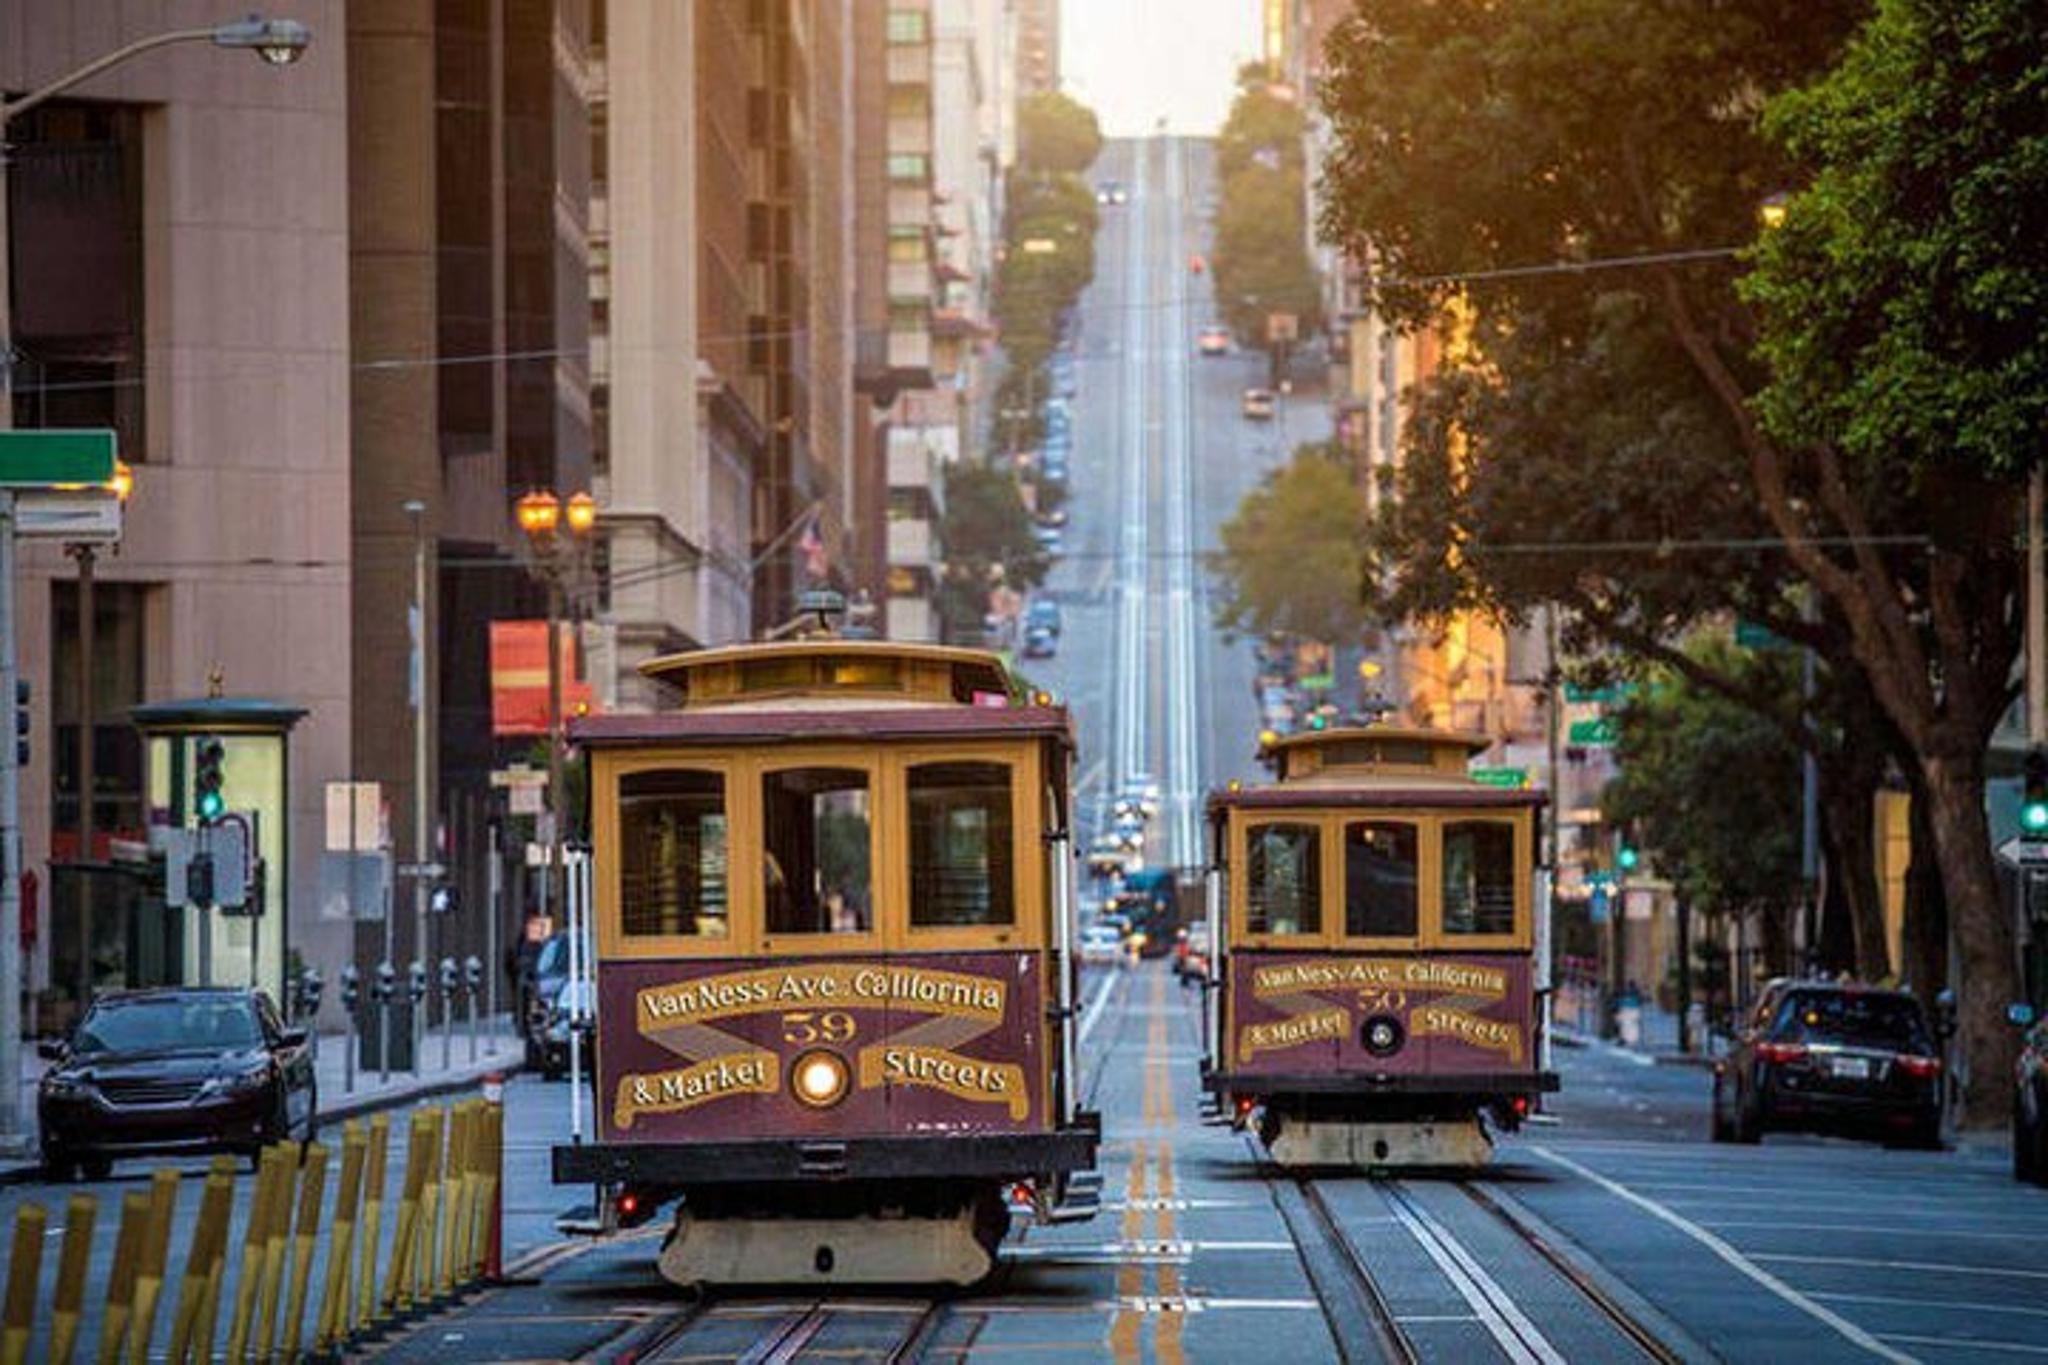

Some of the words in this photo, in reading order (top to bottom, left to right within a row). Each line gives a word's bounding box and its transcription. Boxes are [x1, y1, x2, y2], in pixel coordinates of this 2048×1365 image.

[855, 968, 1000, 1009] California
[783, 1012, 856, 1043] 59
[634, 1076, 656, 1105] &
[660, 1060, 766, 1100] Market
[885, 1050, 1006, 1091] Streets
